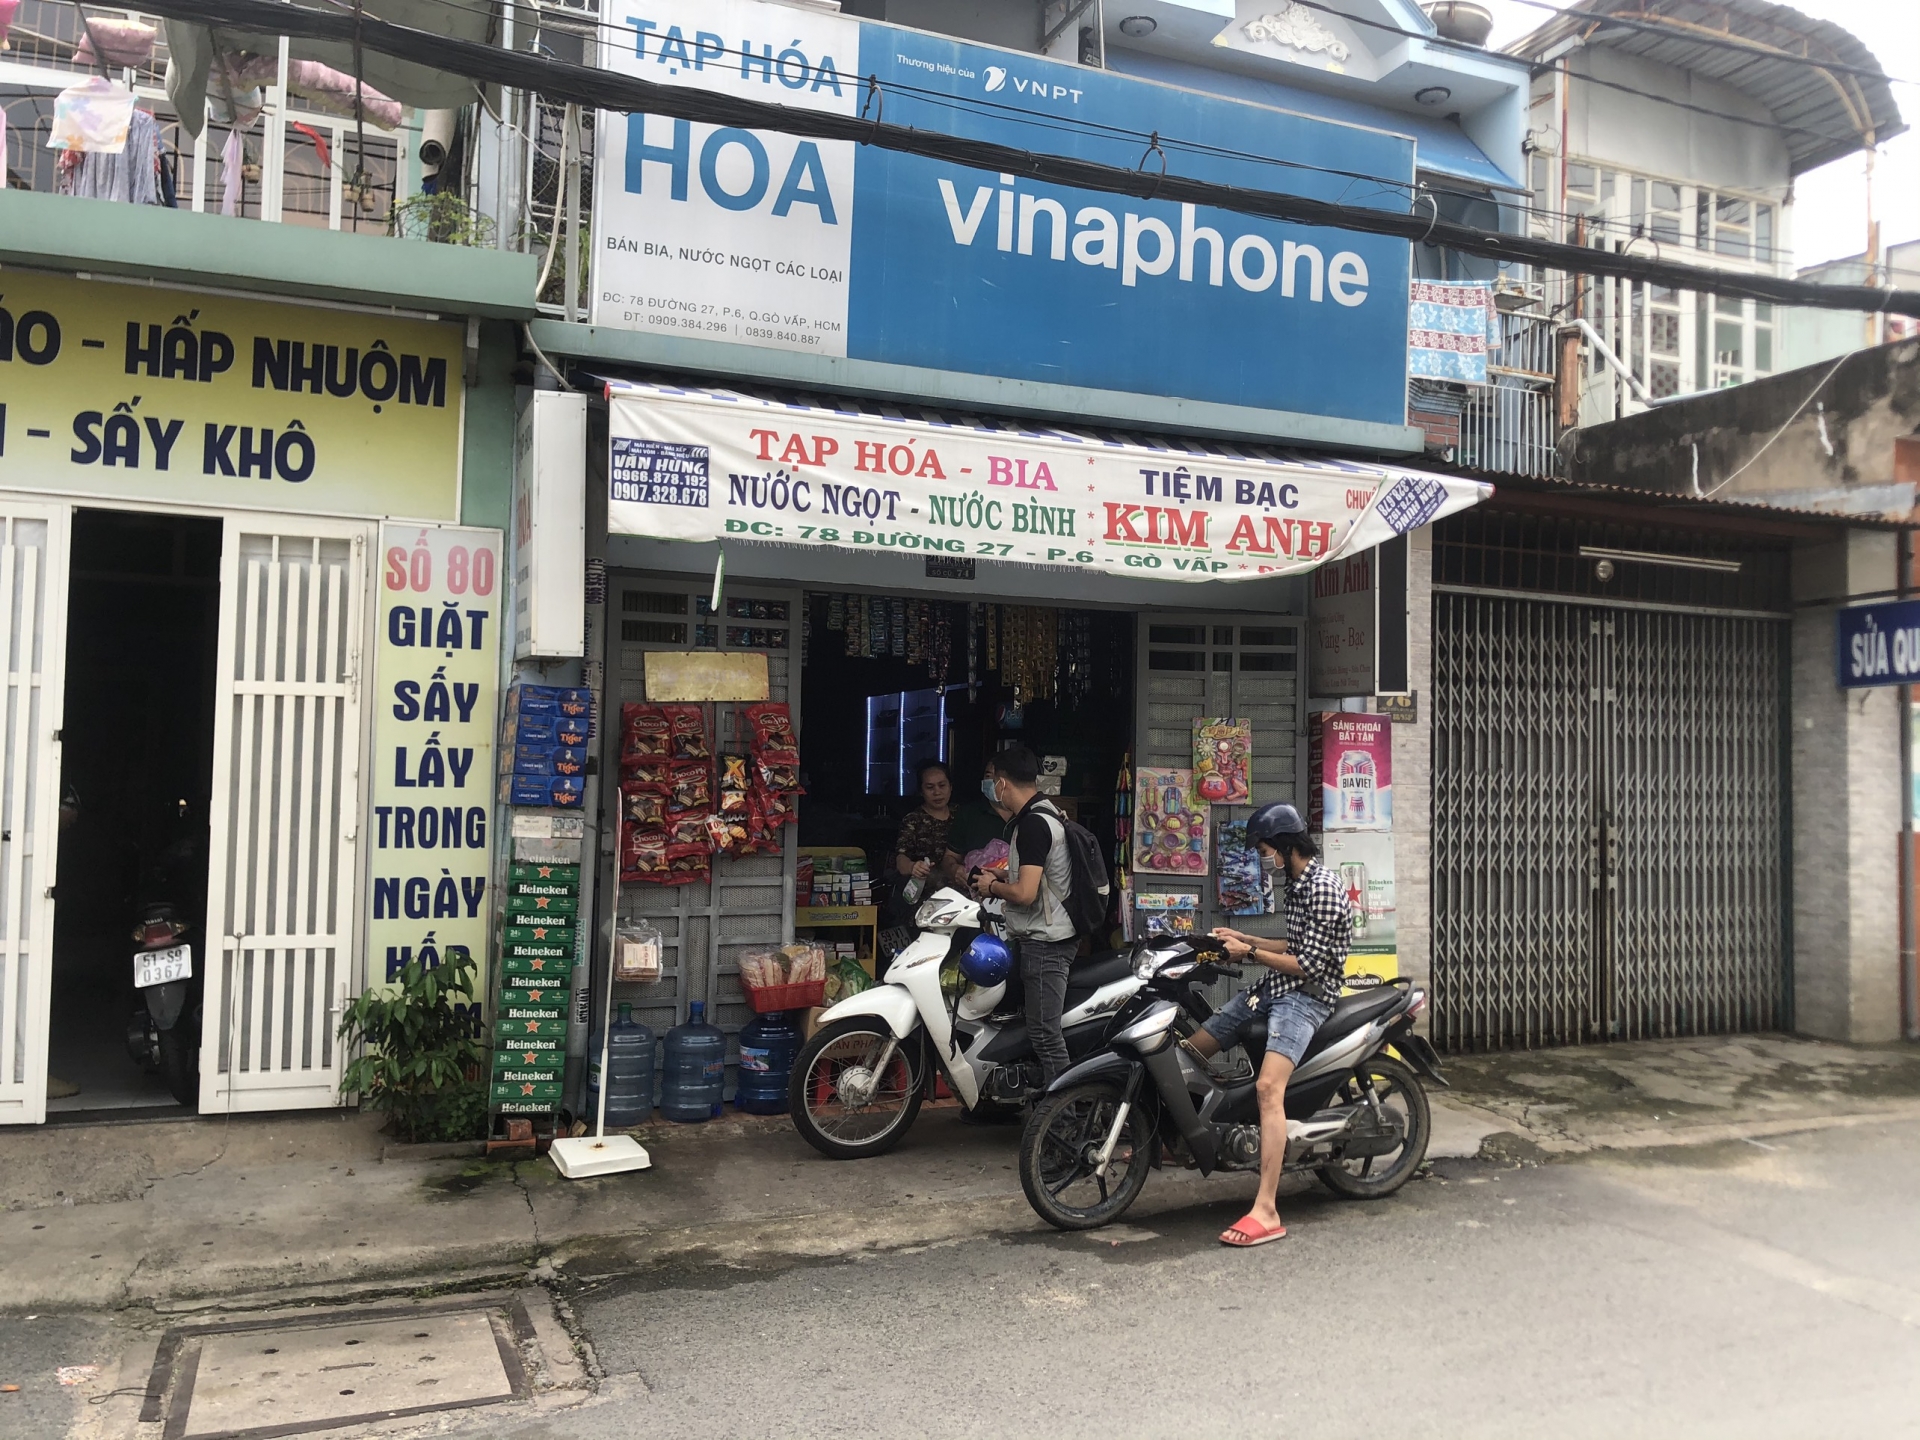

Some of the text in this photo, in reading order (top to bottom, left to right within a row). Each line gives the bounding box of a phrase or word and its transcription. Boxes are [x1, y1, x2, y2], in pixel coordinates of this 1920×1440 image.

[626, 16, 843, 97] TẠP HÓA
[896, 54, 975, 79] Thương hiệu của
[1013, 77, 1083, 104] VNPT
[936, 173, 1370, 308] vinaphone
[607, 236, 843, 284] BÁN BIA, NƯỚC NGỌT CÁC LOẠI
[602, 291, 841, 332] ĐC: 78 ĐƯỜNG 27, P.6, Q.GÒ VẤP, HCM
[623, 311, 821, 345] ĐT: 0909.384.296 0839.840.887
[125, 309, 235, 383] HẤP
[251, 337, 447, 414] NHUỘM
[70, 396, 185, 472] SẤY
[202, 418, 317, 484] KHÔ
[614, 453, 705, 475] VĂN HÙNG
[749, 428, 1059, 492] TẠP HÓA BIA
[613, 468, 707, 487] 0966.878.192
[1139, 466, 1299, 509] TIỆM BẠC
[613, 481, 707, 506] 0907.328.678
[728, 469, 1076, 537] NƯỚC NGỌT NƯỚC BÌNH
[1102, 501, 1334, 558] KIM ANH
[724, 518, 783, 537] ĐC:
[797, 524, 840, 543] 78
[852, 529, 966, 554] ĐƯỜNG
[976, 541, 1015, 556] 27
[1047, 548, 1094, 563] P.6
[1124, 552, 1162, 569] GÒ
[1172, 557, 1229, 574] VẤP
[385, 529, 494, 596] SỐ 80
[1315, 551, 1369, 598] Kim Anh
[388, 600, 489, 658] GIẶT
[1348, 626, 1366, 651] Bạc
[1851, 613, 1889, 678] SỬA
[393, 665, 479, 723] SẤY
[562, 703, 585, 715] Tiger
[1332, 719, 1381, 733] SẢNG KHOÁI
[1338, 731, 1374, 743] BẤT TẬN
[560, 733, 583, 745] Tiger
[394, 730, 474, 788] LẤY
[557, 763, 580, 774] Tiger
[1342, 777, 1354, 789] BIA
[553, 793, 577, 805] Tiger
[374, 806, 486, 849] TRONG
[529, 854, 571, 865] eineken
[373, 868, 486, 920] NGÀY
[518, 884, 567, 895] Heineken
[516, 915, 565, 925] Heineken
[513, 946, 563, 956] Heineken
[143, 963, 183, 984] 0367
[511, 977, 560, 987] Heineken
[1345, 977, 1380, 986] STRONGBOW
[508, 1008, 558, 1018] Heineken
[506, 1040, 556, 1050] Heineken
[503, 1071, 553, 1081] Heineken
[501, 1102, 551, 1113] Heineken
